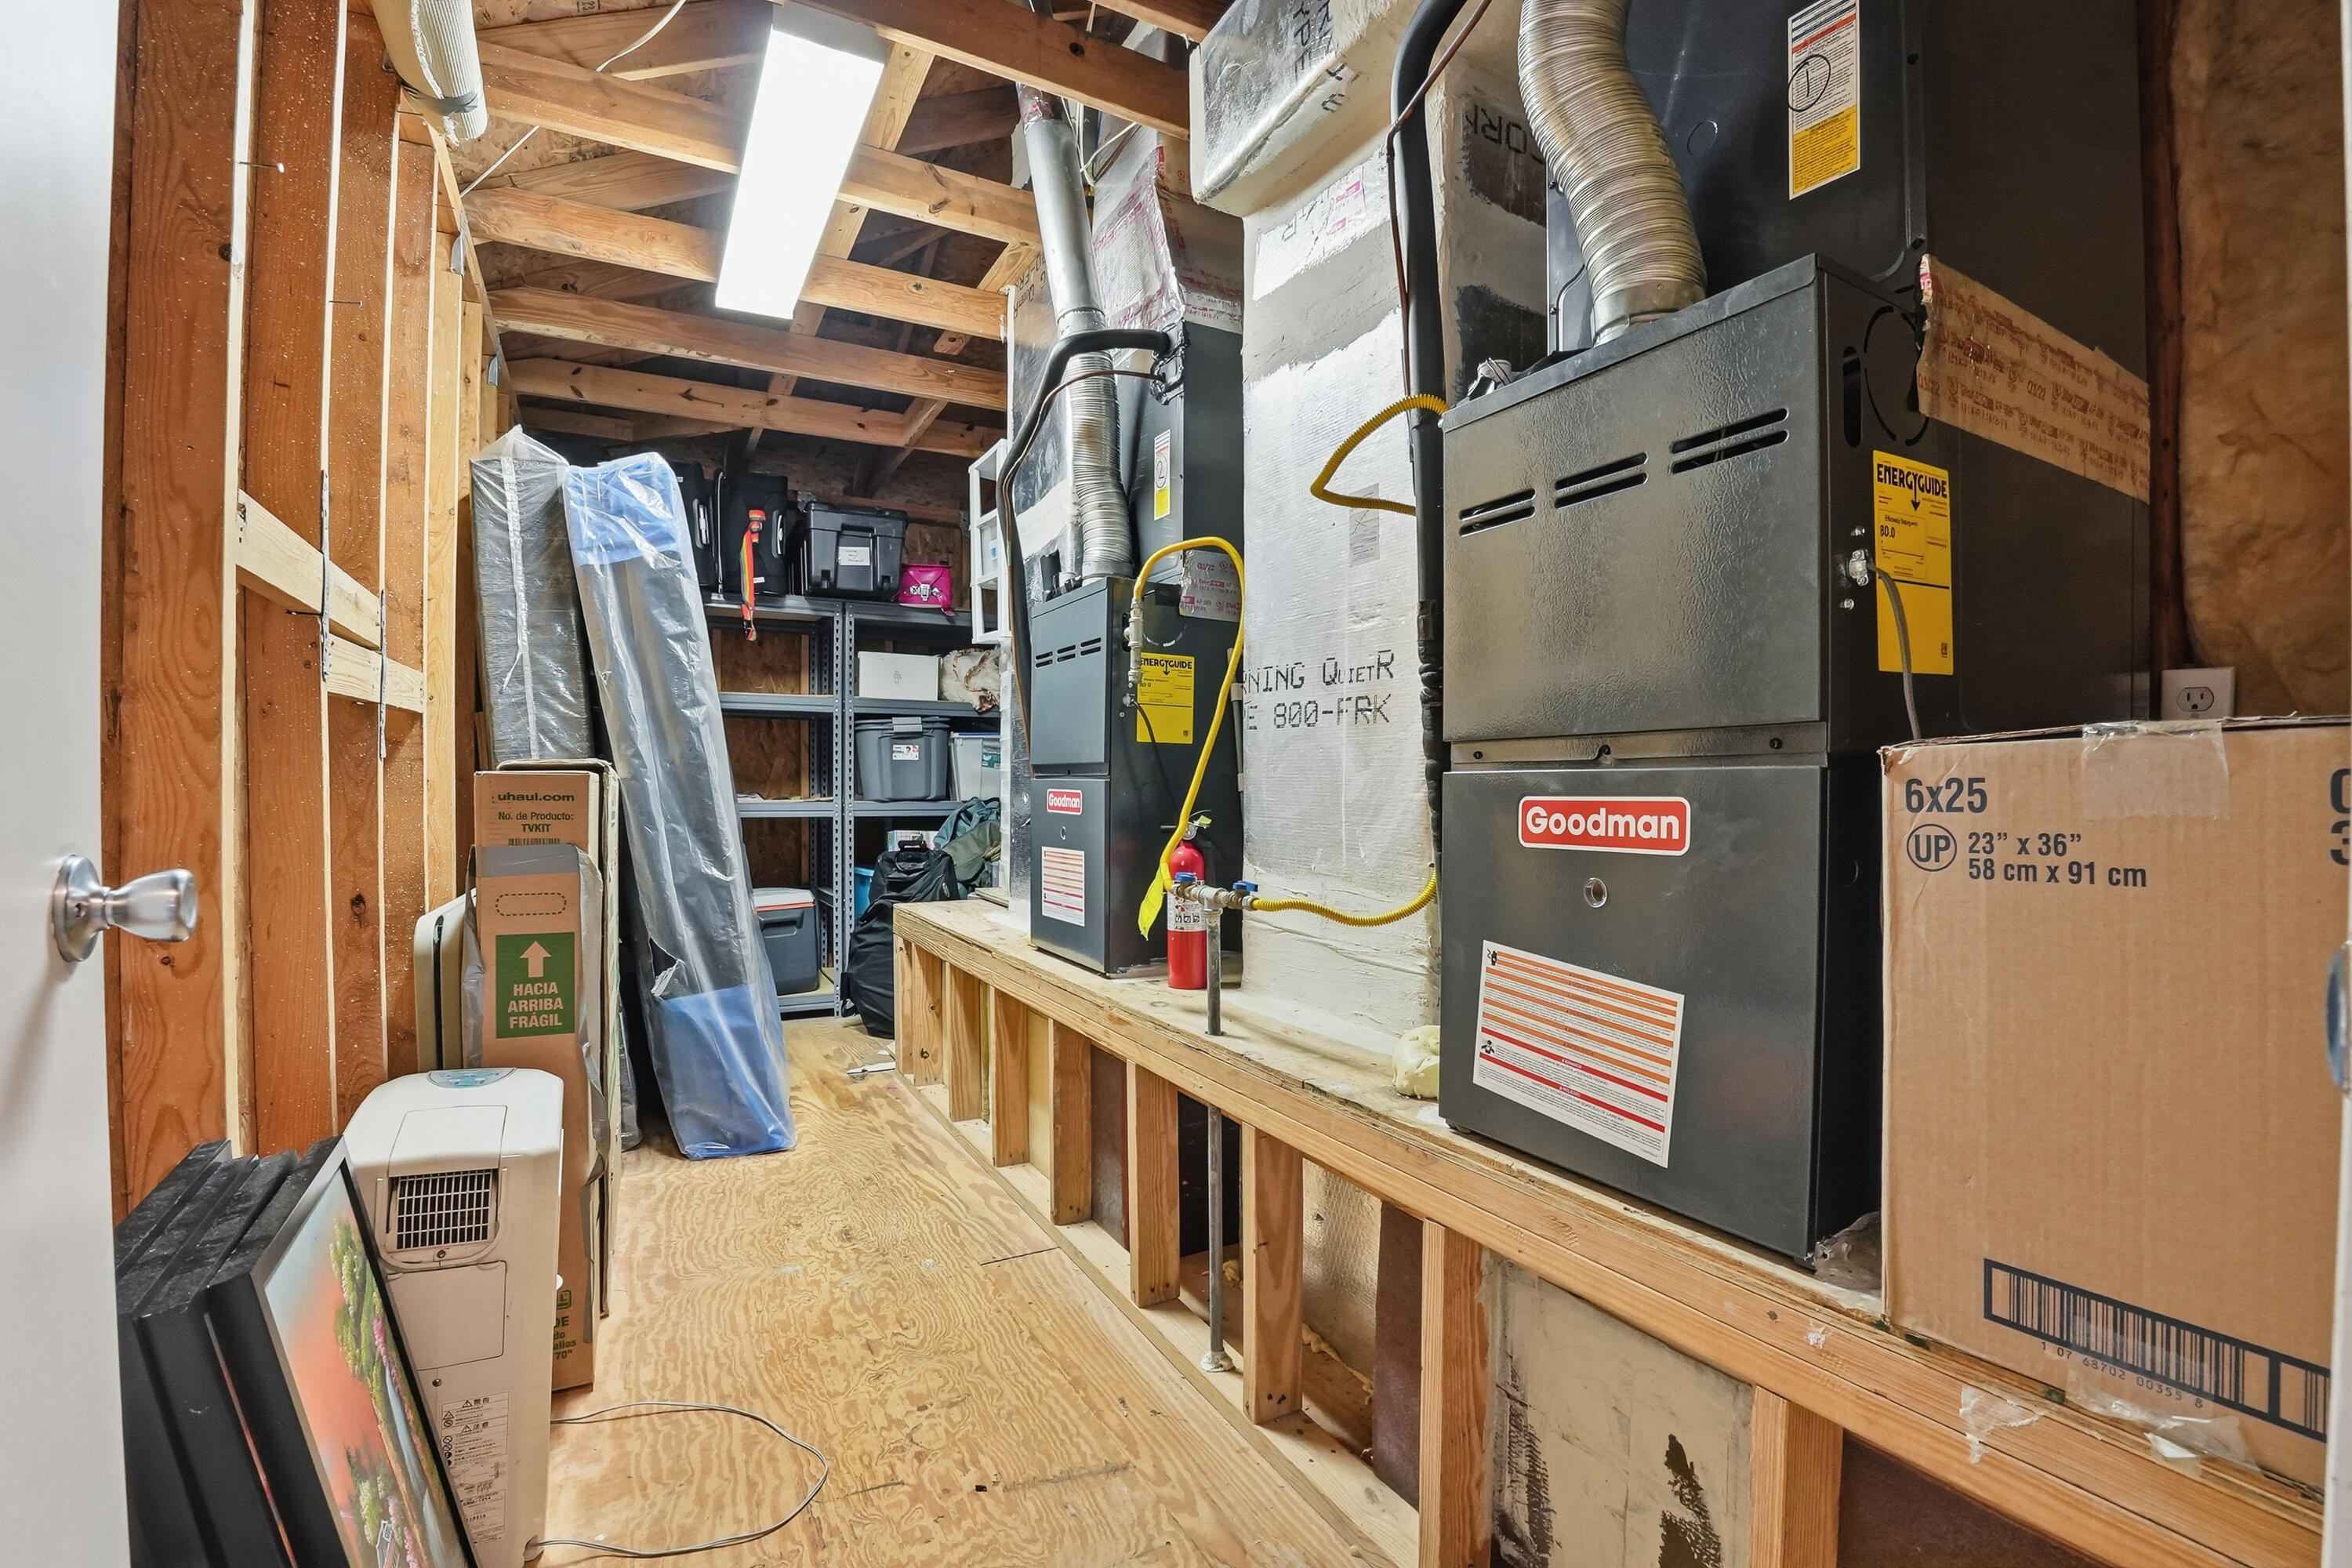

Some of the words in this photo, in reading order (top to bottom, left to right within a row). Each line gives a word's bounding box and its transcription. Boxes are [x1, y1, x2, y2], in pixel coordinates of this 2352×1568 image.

[1156, 460, 1165, 479] 2
[1876, 463, 1947, 499] ENERGYGUIDE
[1273, 693, 1392, 729] 800-FRK
[497, 792, 575, 801] uhaul.com
[1049, 793, 1080, 809] Goodman
[1905, 776, 1988, 814] 6x25
[499, 811, 514, 821] No.
[516, 811, 528, 821] de
[530, 811, 575, 821] Producto:
[1526, 805, 1680, 840] Goodman
[521, 823, 552, 833] TVKIT
[1914, 833, 1951, 863] UP
[2016, 837, 2031, 855] x
[1969, 858, 1996, 880] 58
[2003, 862, 2038, 883] cm
[2045, 864, 2060, 884] x
[2067, 861, 2096, 885] 91
[2107, 866, 2147, 887] cm
[513, 982, 558, 996] HACIA
[507, 997, 564, 1013] ARRIBA
[510, 1011, 563, 1029] FRÁGIL
[2041, 1341, 2046, 1350] 1
[2056, 1346, 2072, 1359] 07
[2082, 1356, 2125, 1381] 68702
[2136, 1377, 2183, 1401] 00355
[2194, 1397, 2203, 1409] 8
